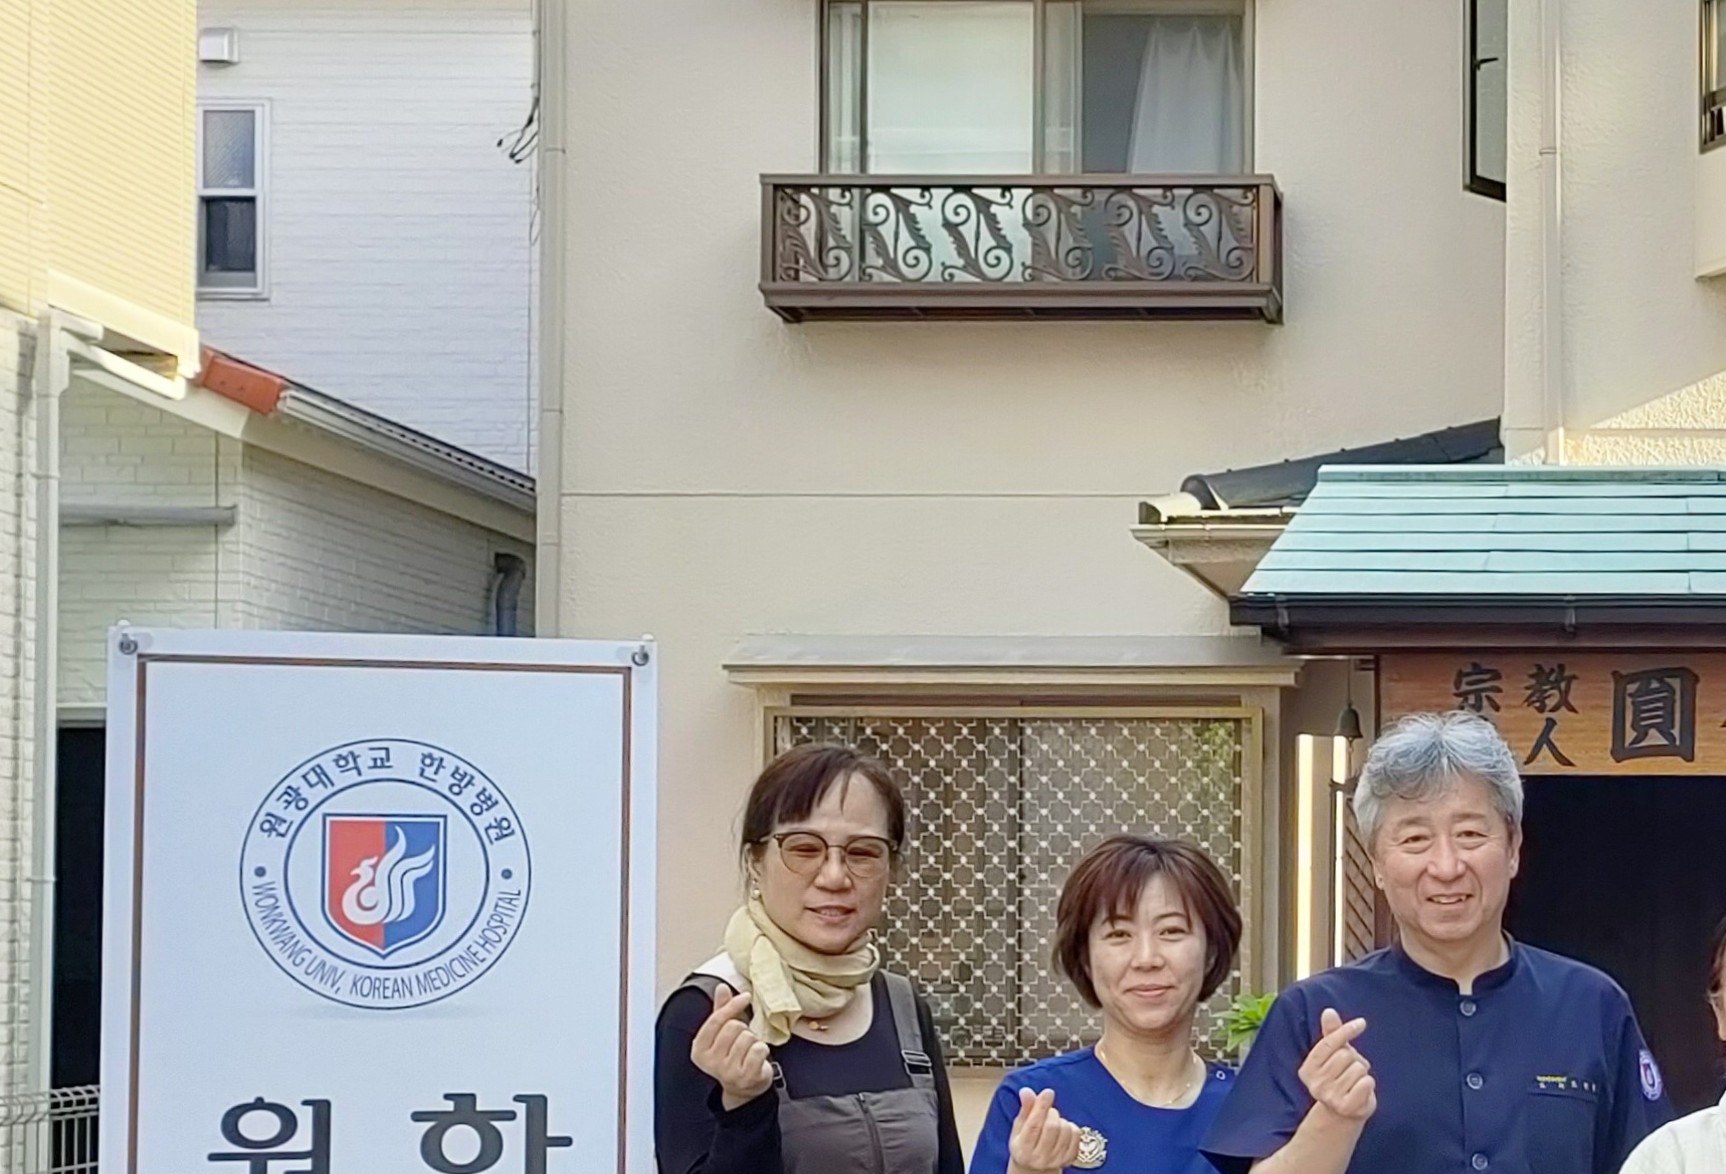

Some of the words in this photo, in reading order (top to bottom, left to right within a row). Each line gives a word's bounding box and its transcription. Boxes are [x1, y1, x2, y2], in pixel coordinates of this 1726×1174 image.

[1452, 661, 1579, 714] 宗教
[259, 746, 393, 839] 원광대학교
[418, 751, 516, 845] 한방병원
[252, 881, 313, 968] WONKWANG
[349, 973, 414, 1000] KOREAN
[412, 944, 487, 997] MEDICINE
[480, 888, 522, 956] HOSPITAL
